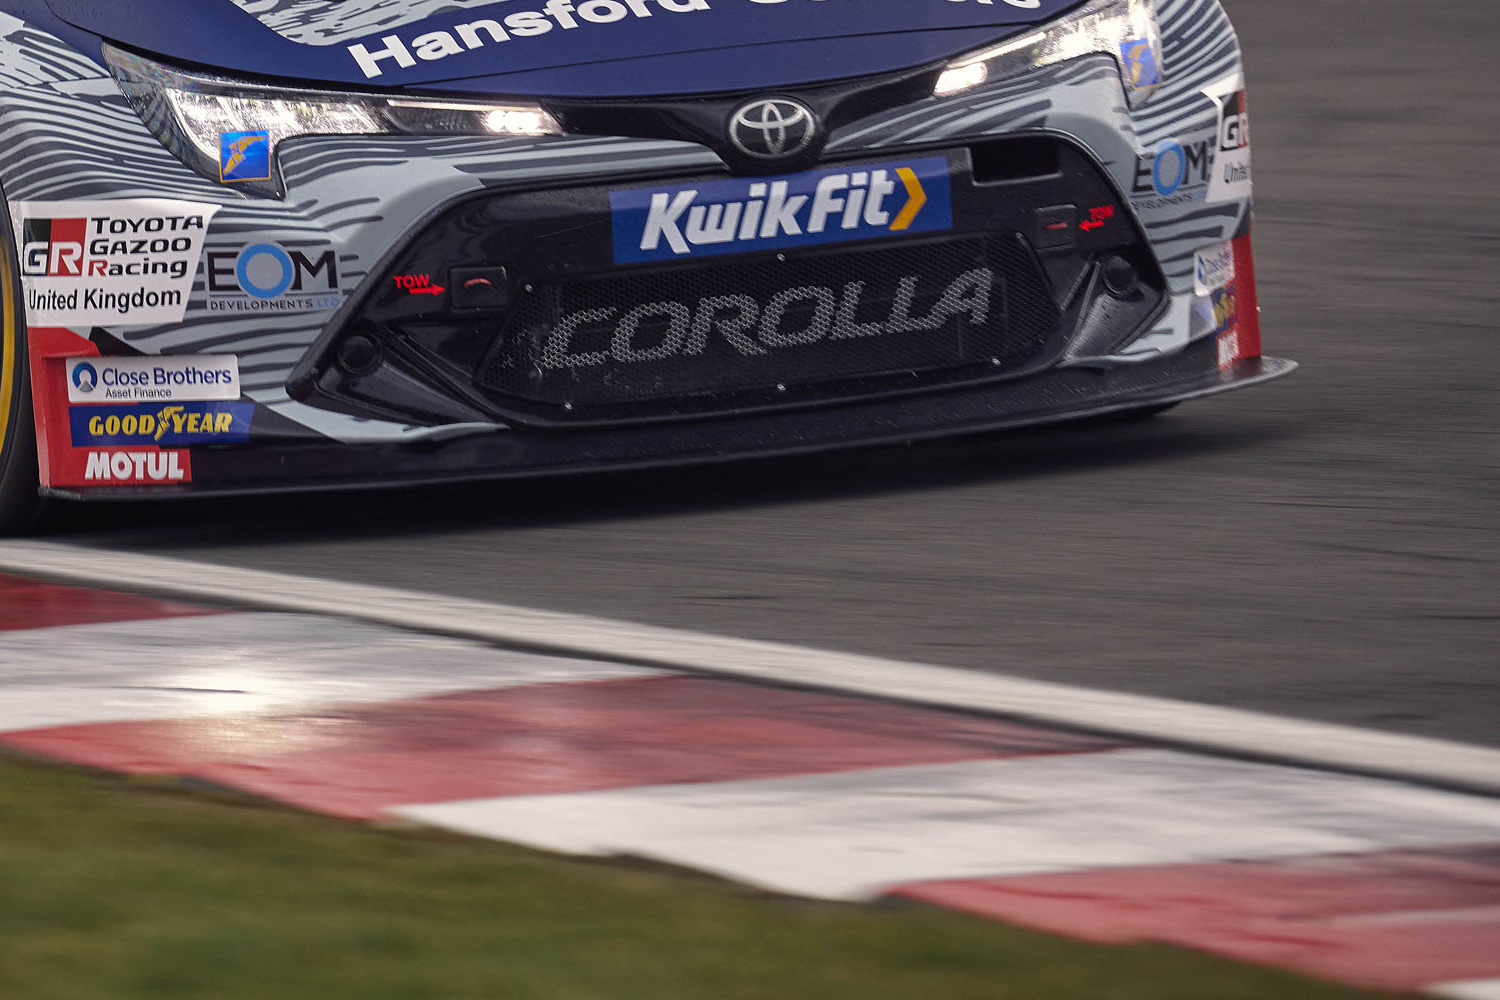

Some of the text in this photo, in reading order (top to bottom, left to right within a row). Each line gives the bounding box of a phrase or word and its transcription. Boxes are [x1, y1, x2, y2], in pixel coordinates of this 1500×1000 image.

[90, 215, 204, 235] TOYOTA
[24, 230, 84, 277] GR
[89, 238, 192, 256] GAZOO
[88, 258, 188, 279] Racing
[207, 242, 339, 299] EOM
[392, 272, 430, 289] TOW
[28, 287, 182, 313] United Kingdom
[210, 299, 313, 311] DEVELOPMENTS
[540, 266, 994, 371] COROLLA
[102, 366, 232, 387] Close Brothers
[105, 387, 172, 399] Asset Finance
[88, 409, 233, 437] GOODYEAR
[85, 451, 185, 481] MOTUL
